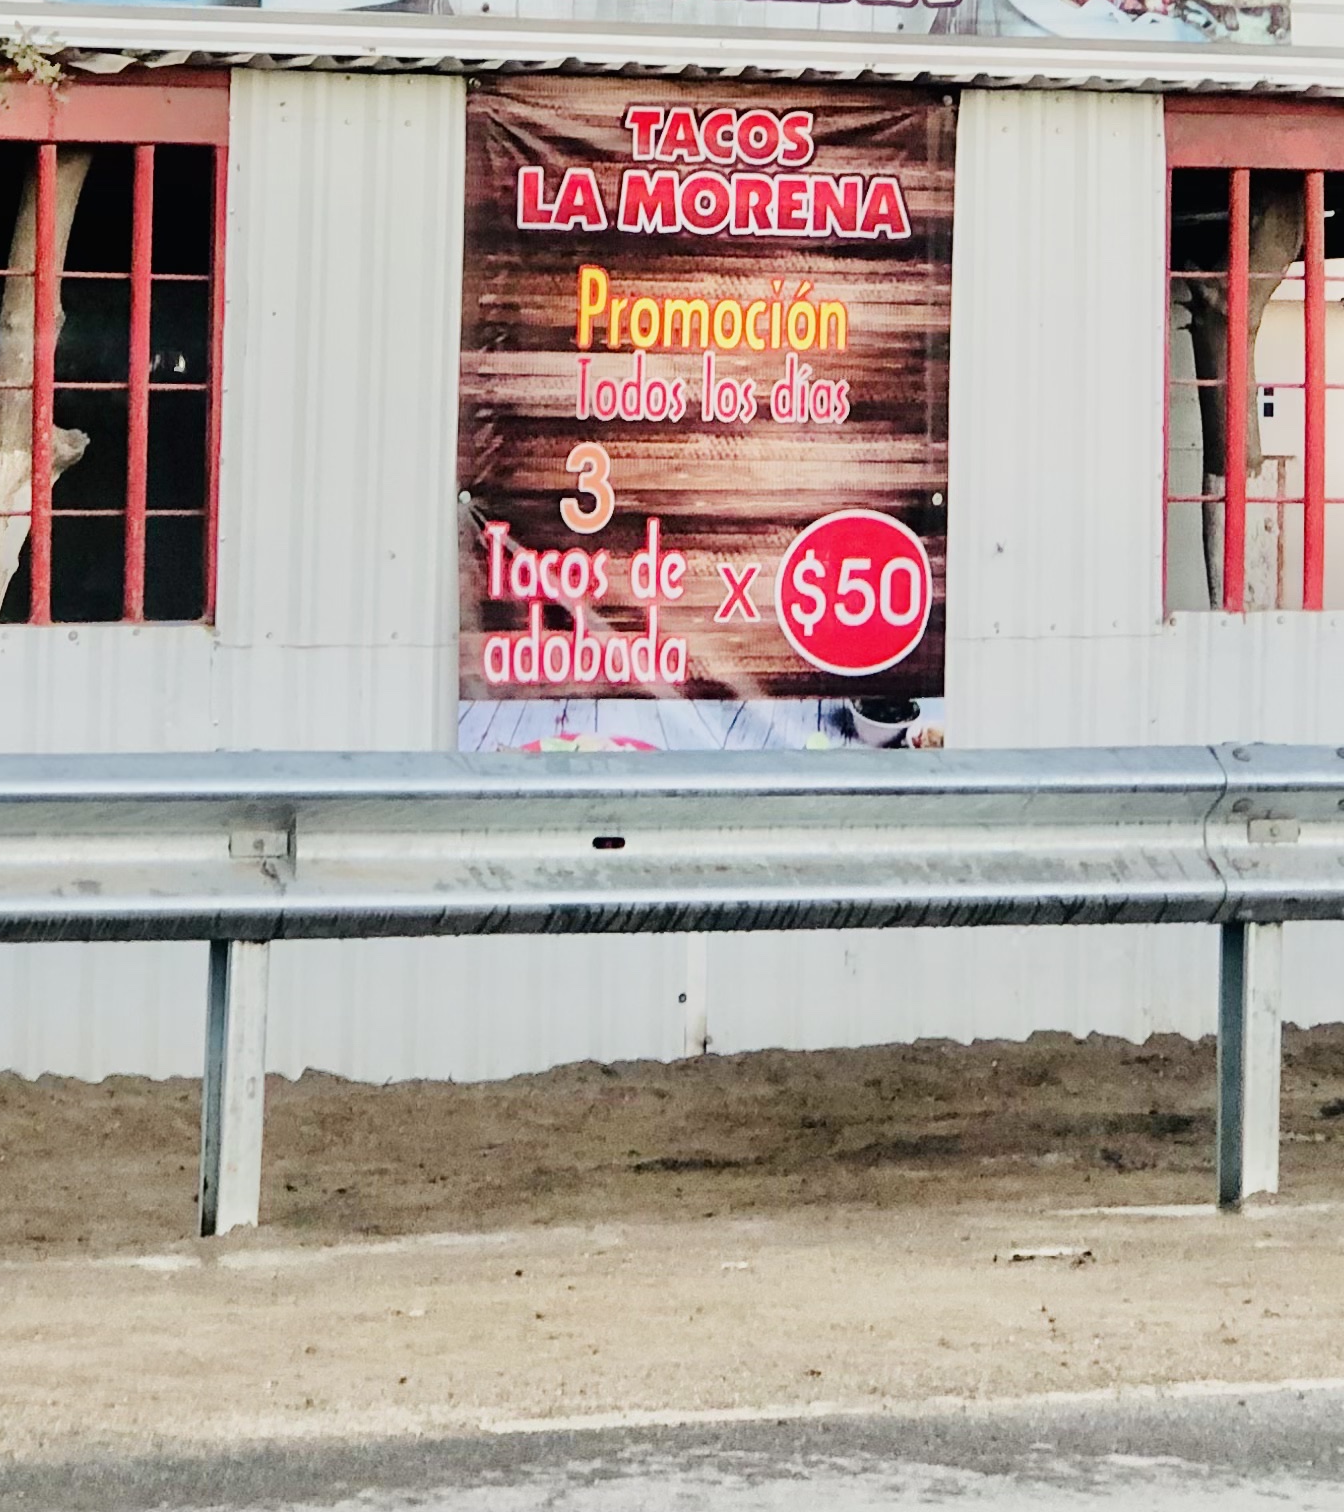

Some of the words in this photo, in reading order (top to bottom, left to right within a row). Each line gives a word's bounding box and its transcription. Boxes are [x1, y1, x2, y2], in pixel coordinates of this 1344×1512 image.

[625, 106, 814, 166] TACOS
[517, 167, 607, 231] LA
[618, 170, 911, 238] MORENA
[576, 265, 847, 351] Promoción
[576, 352, 686, 422] Todos
[701, 351, 757, 423] los
[770, 353, 850, 423] días
[560, 442, 614, 534] 3
[484, 520, 607, 600] Tacos
[630, 517, 687, 600] de
[791, 549, 922, 636] $50
[483, 602, 688, 683] adobada
